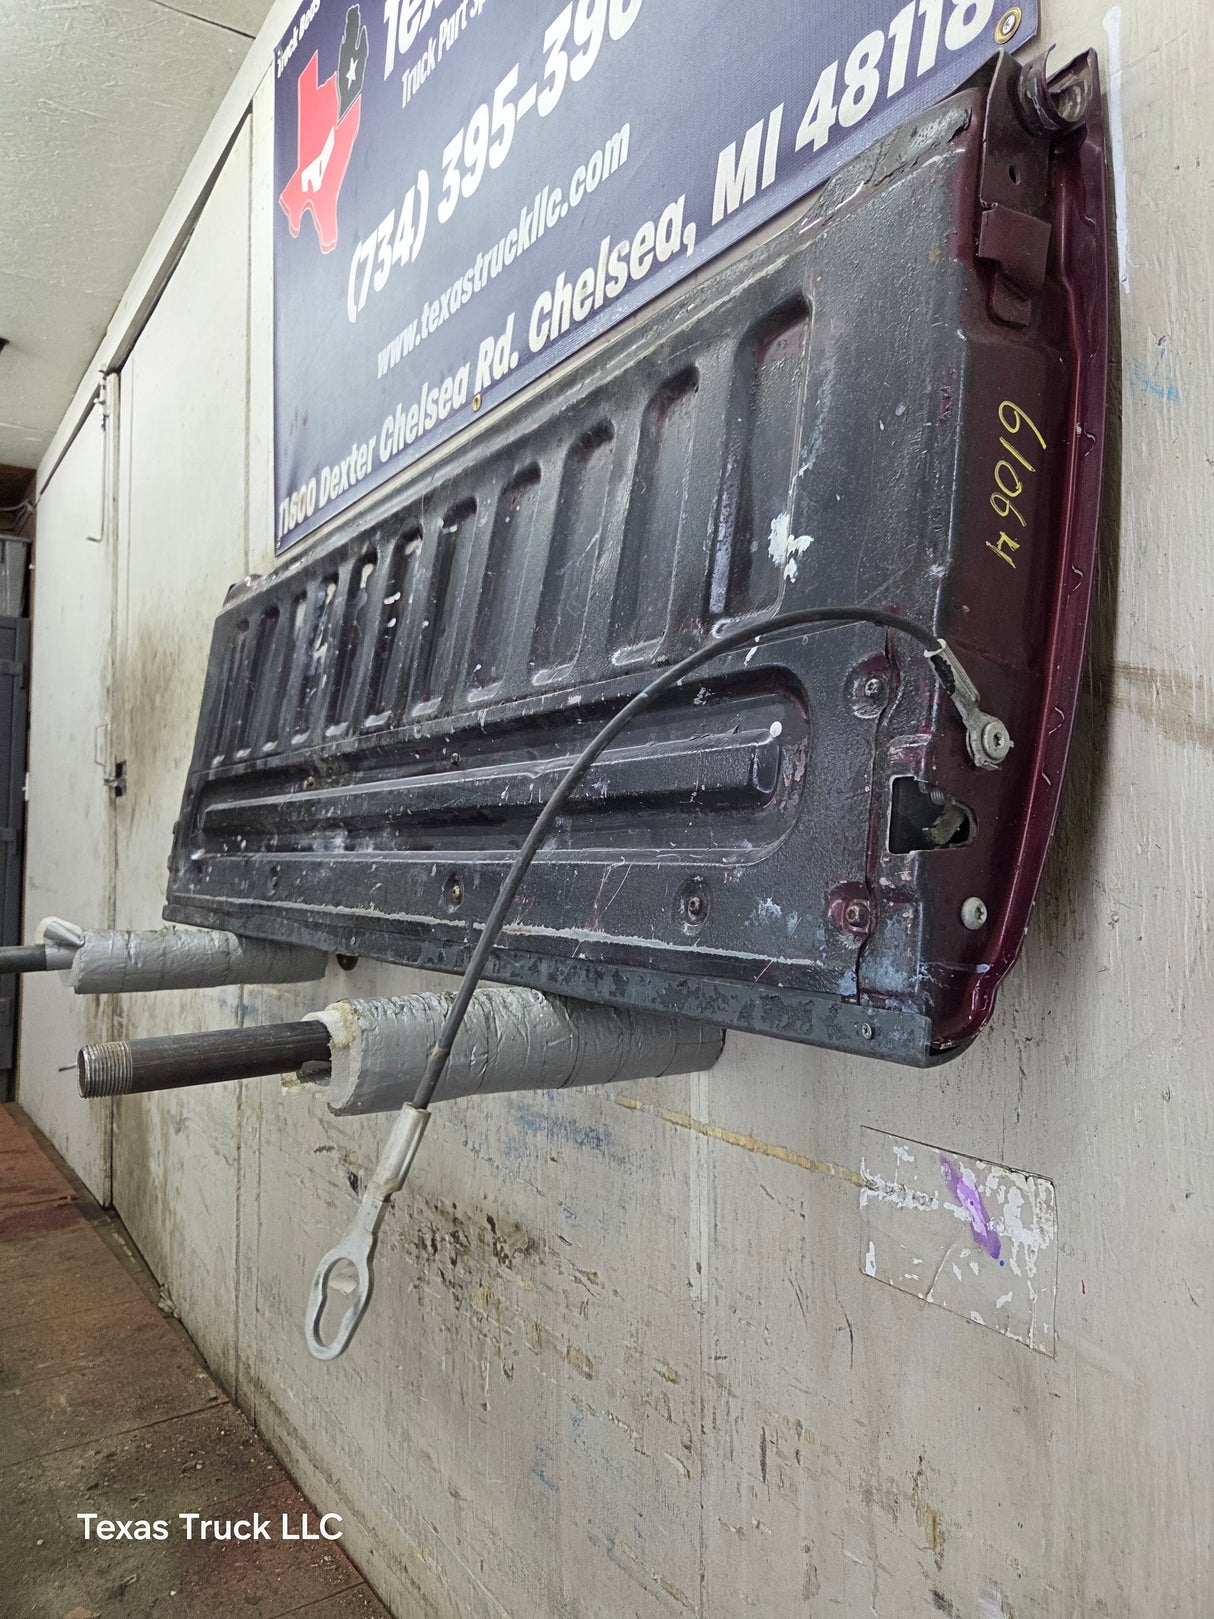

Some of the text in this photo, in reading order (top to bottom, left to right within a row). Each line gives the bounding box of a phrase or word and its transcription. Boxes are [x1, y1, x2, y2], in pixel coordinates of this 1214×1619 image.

[402, 0, 469, 109] Truck Part
[319, 435, 377, 509] Dexter
[379, 361, 470, 463] Chelsea
[474, 312, 519, 396] Rd.
[529, 194, 697, 353] Chelsea,
[711, 103, 784, 226] MI
[795, 0, 995, 153] 48118
[347, 169, 429, 323] (734)
[377, 122, 631, 379] www.texastruckllc.com
[984, 400, 1047, 569] 61064
